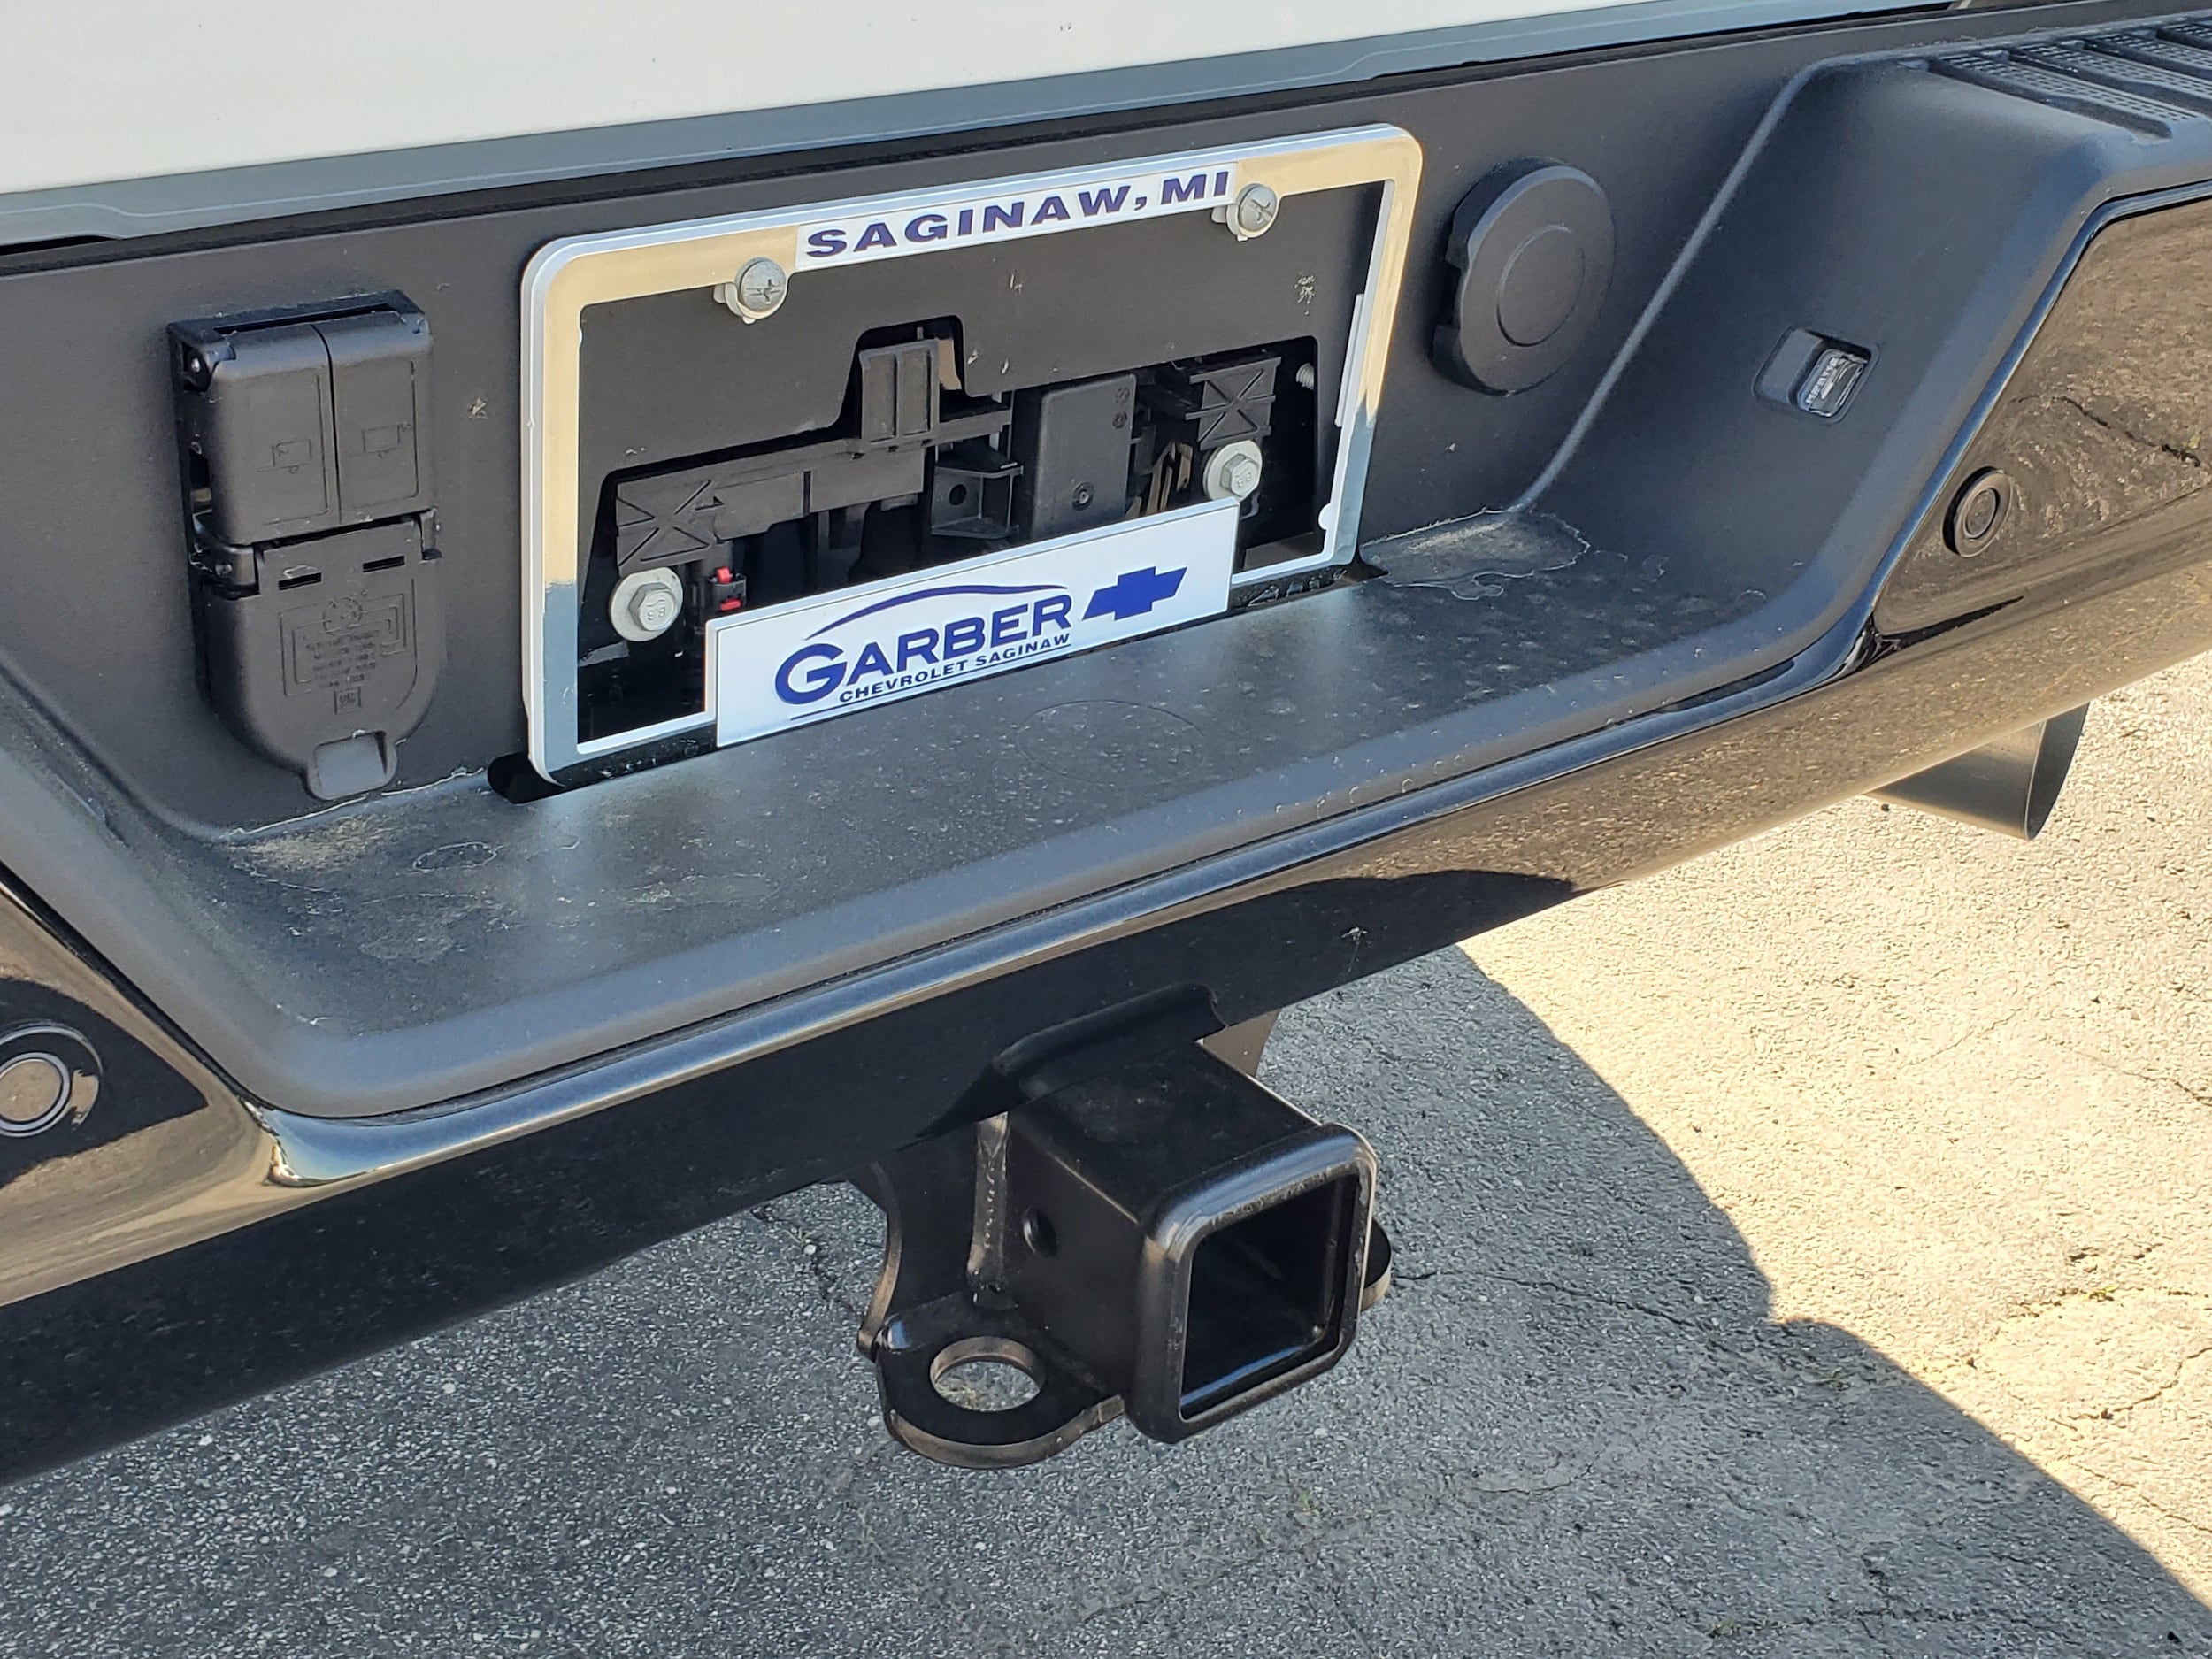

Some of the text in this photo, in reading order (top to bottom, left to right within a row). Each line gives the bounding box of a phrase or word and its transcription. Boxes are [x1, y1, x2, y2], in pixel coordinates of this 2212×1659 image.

[806, 171, 1229, 257] SAGINAW, MI
[774, 594, 1072, 705] GARBER
[839, 633, 1070, 703] CHEVROLET SAGINAW
